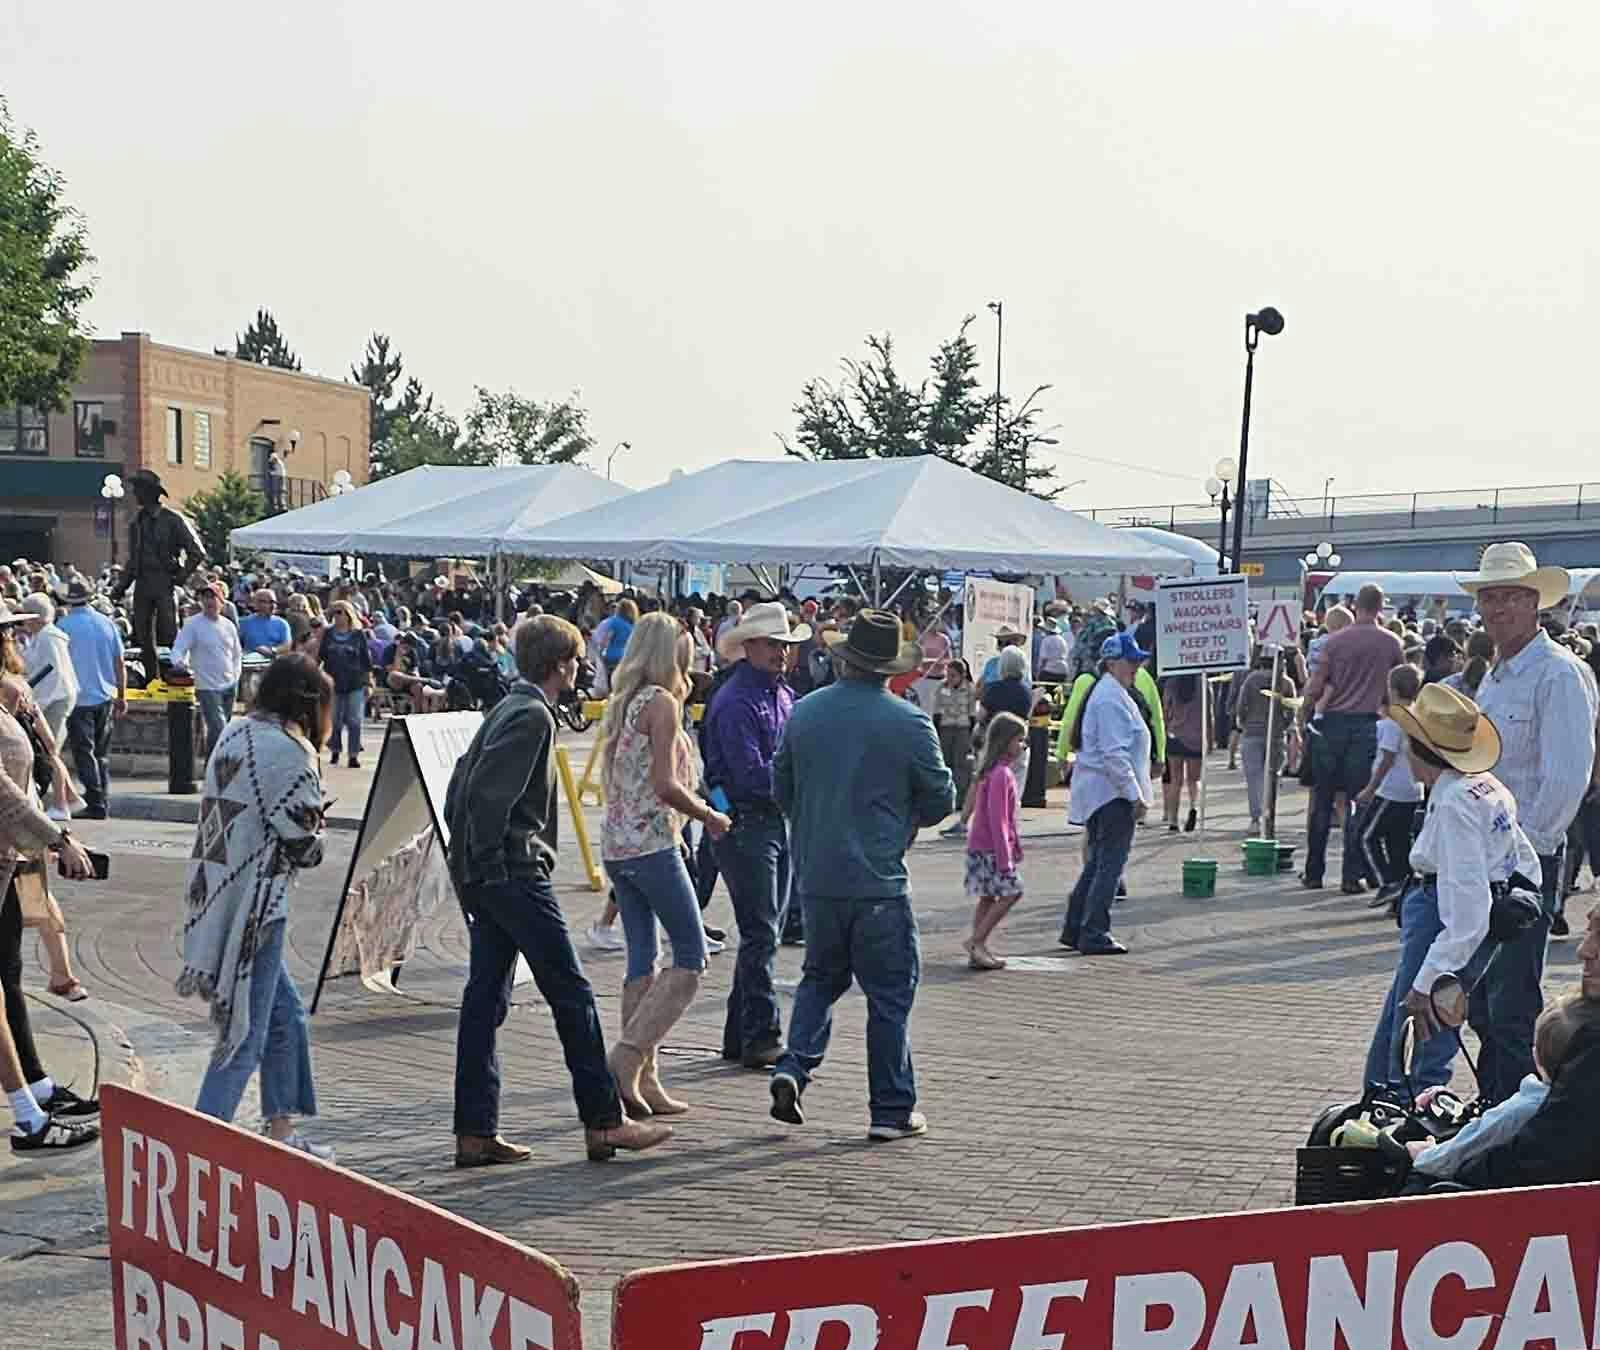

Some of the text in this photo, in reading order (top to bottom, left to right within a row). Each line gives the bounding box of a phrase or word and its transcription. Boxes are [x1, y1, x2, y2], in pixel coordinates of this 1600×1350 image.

[1169, 588, 1234, 601] STROLLERS
[1174, 603, 1232, 617] WAGONS &
[1162, 617, 1242, 632] WHEELCHAIRS
[1180, 634, 1226, 648] KEEP TO
[1178, 650, 1228, 664] THE LEFT
[120, 1126, 246, 1281] FREE
